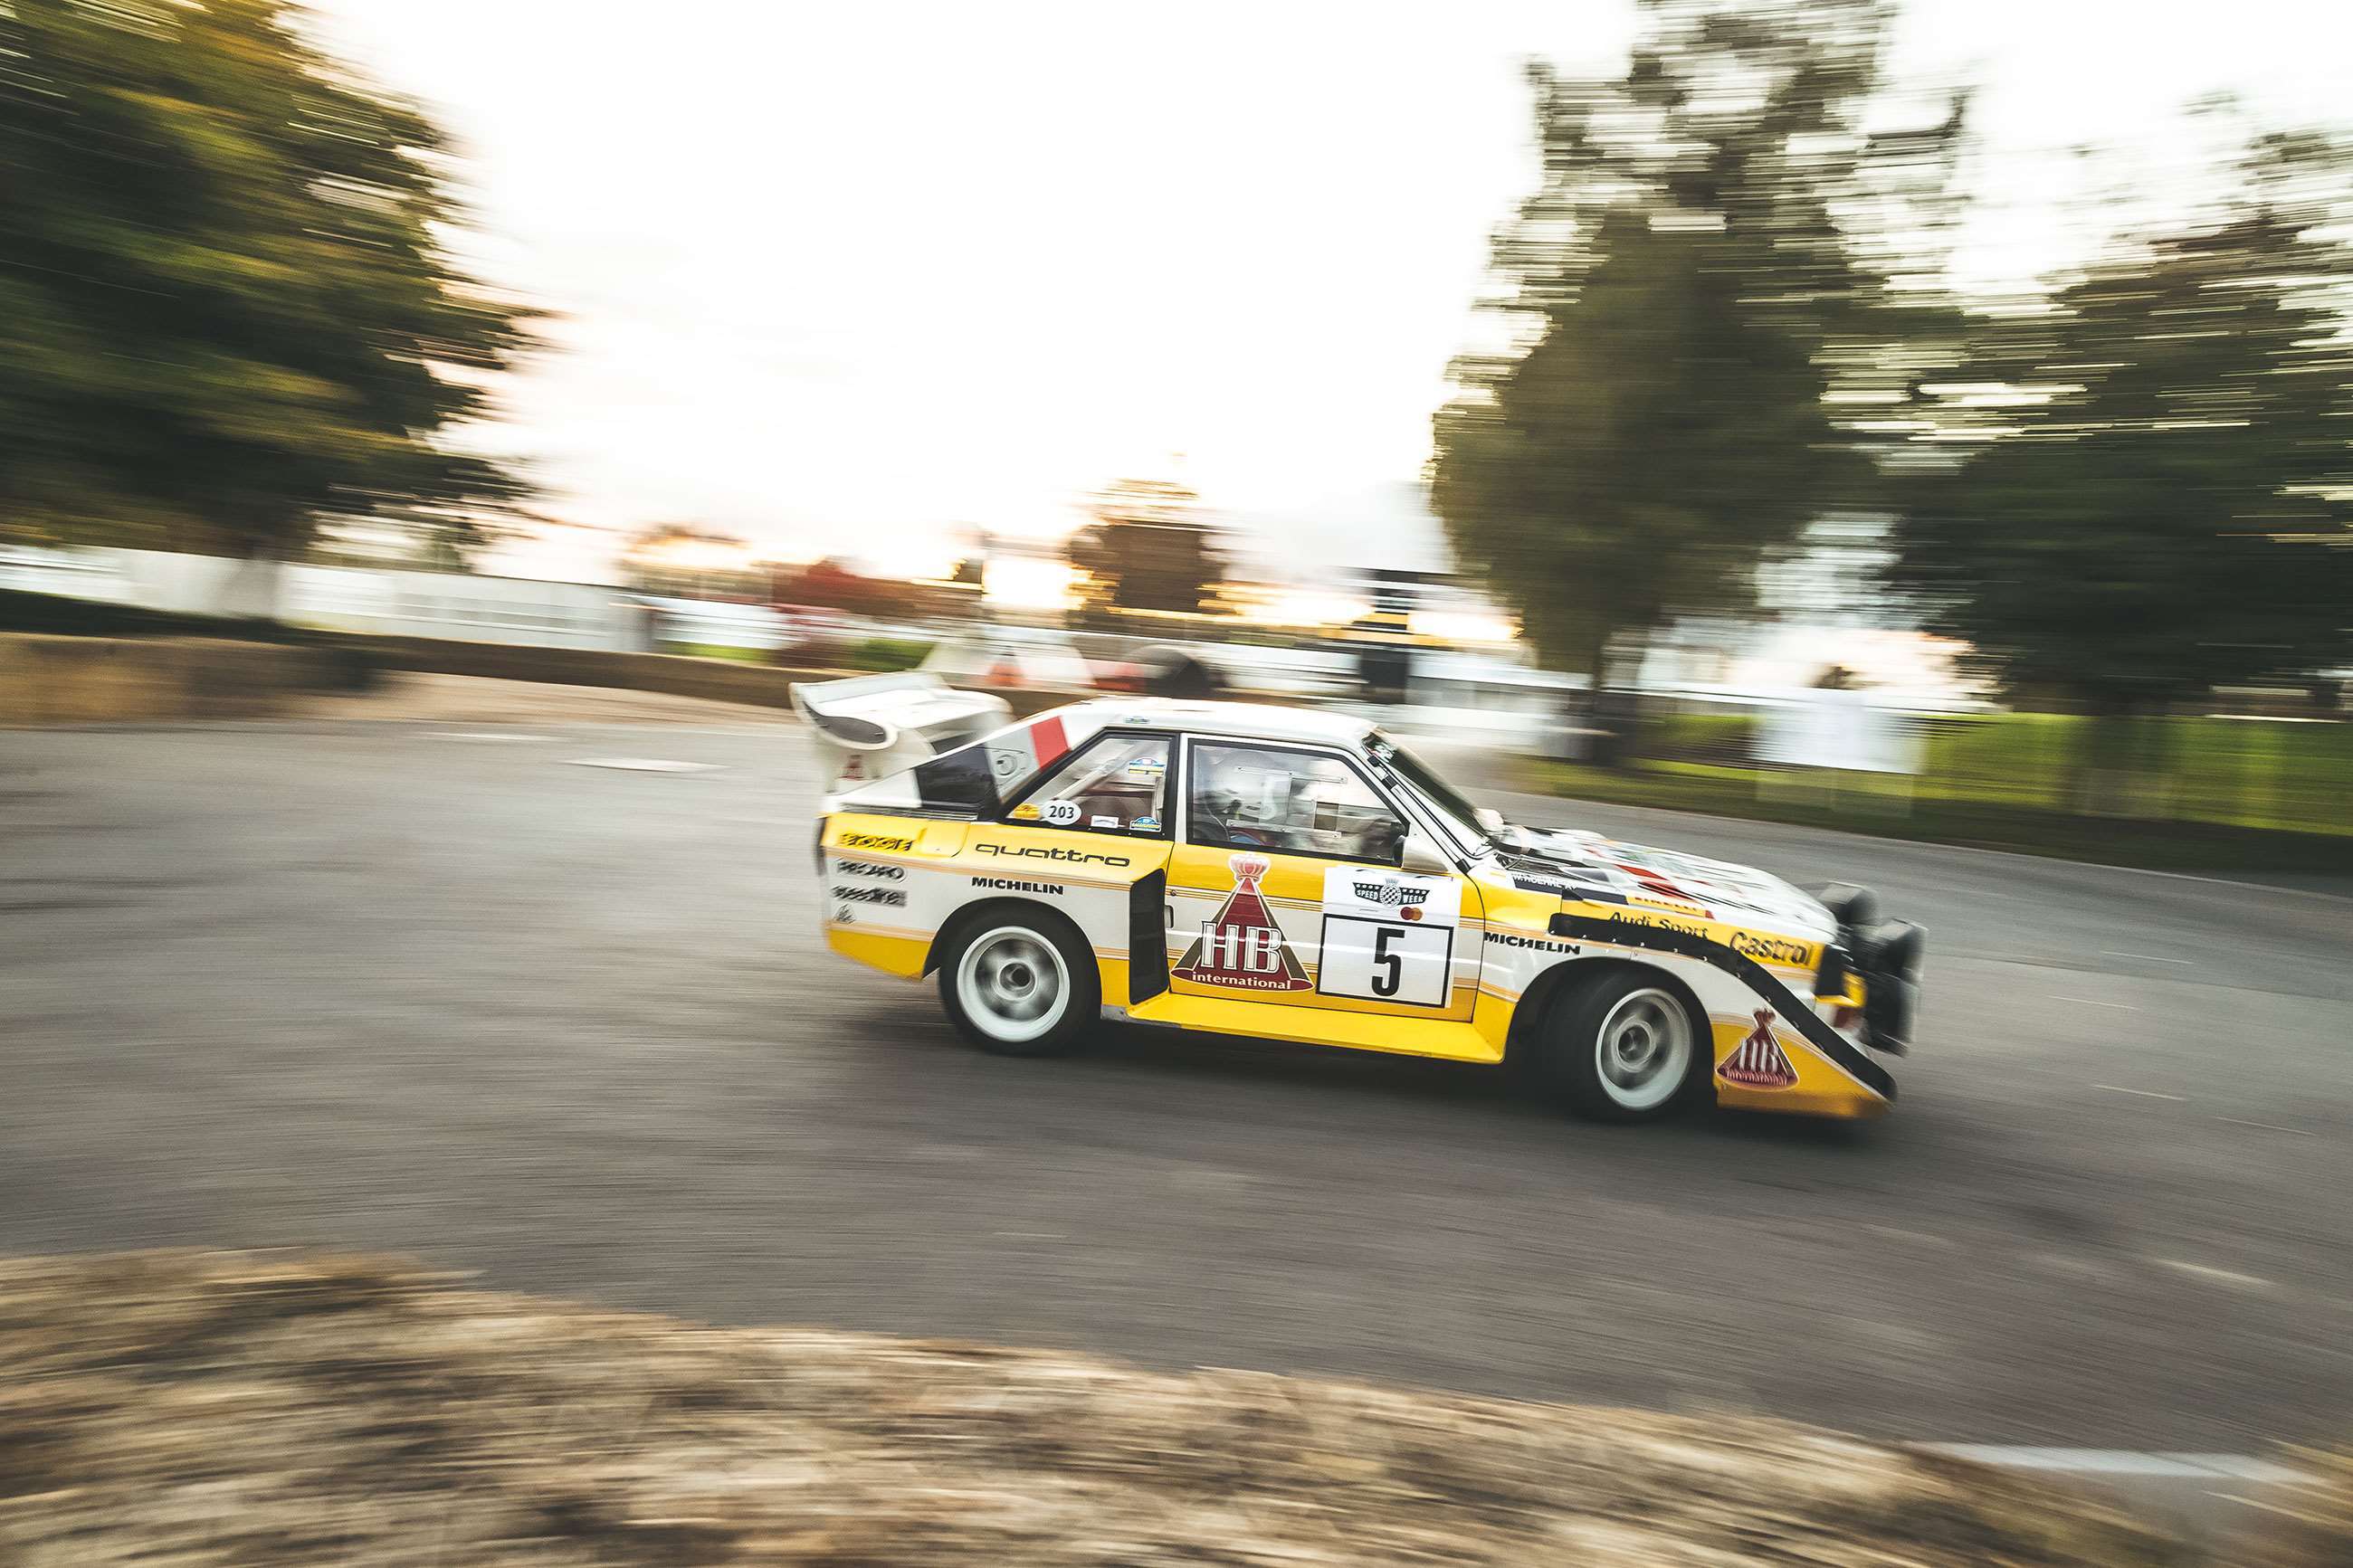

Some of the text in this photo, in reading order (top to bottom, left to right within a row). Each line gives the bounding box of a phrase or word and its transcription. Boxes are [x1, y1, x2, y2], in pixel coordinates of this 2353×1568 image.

[1049, 805, 1075, 820] 203
[976, 843, 1130, 868] quattro
[971, 876, 1064, 895] MICHELIN
[1356, 889, 1425, 904] SPEED WEEK
[1609, 911, 1652, 927] Audi
[1201, 920, 1282, 974] HB
[1483, 931, 1581, 955] MICHELIN
[1729, 931, 1811, 965] Castrol
[1371, 927, 1405, 997] 5
[1191, 971, 1291, 990] international
